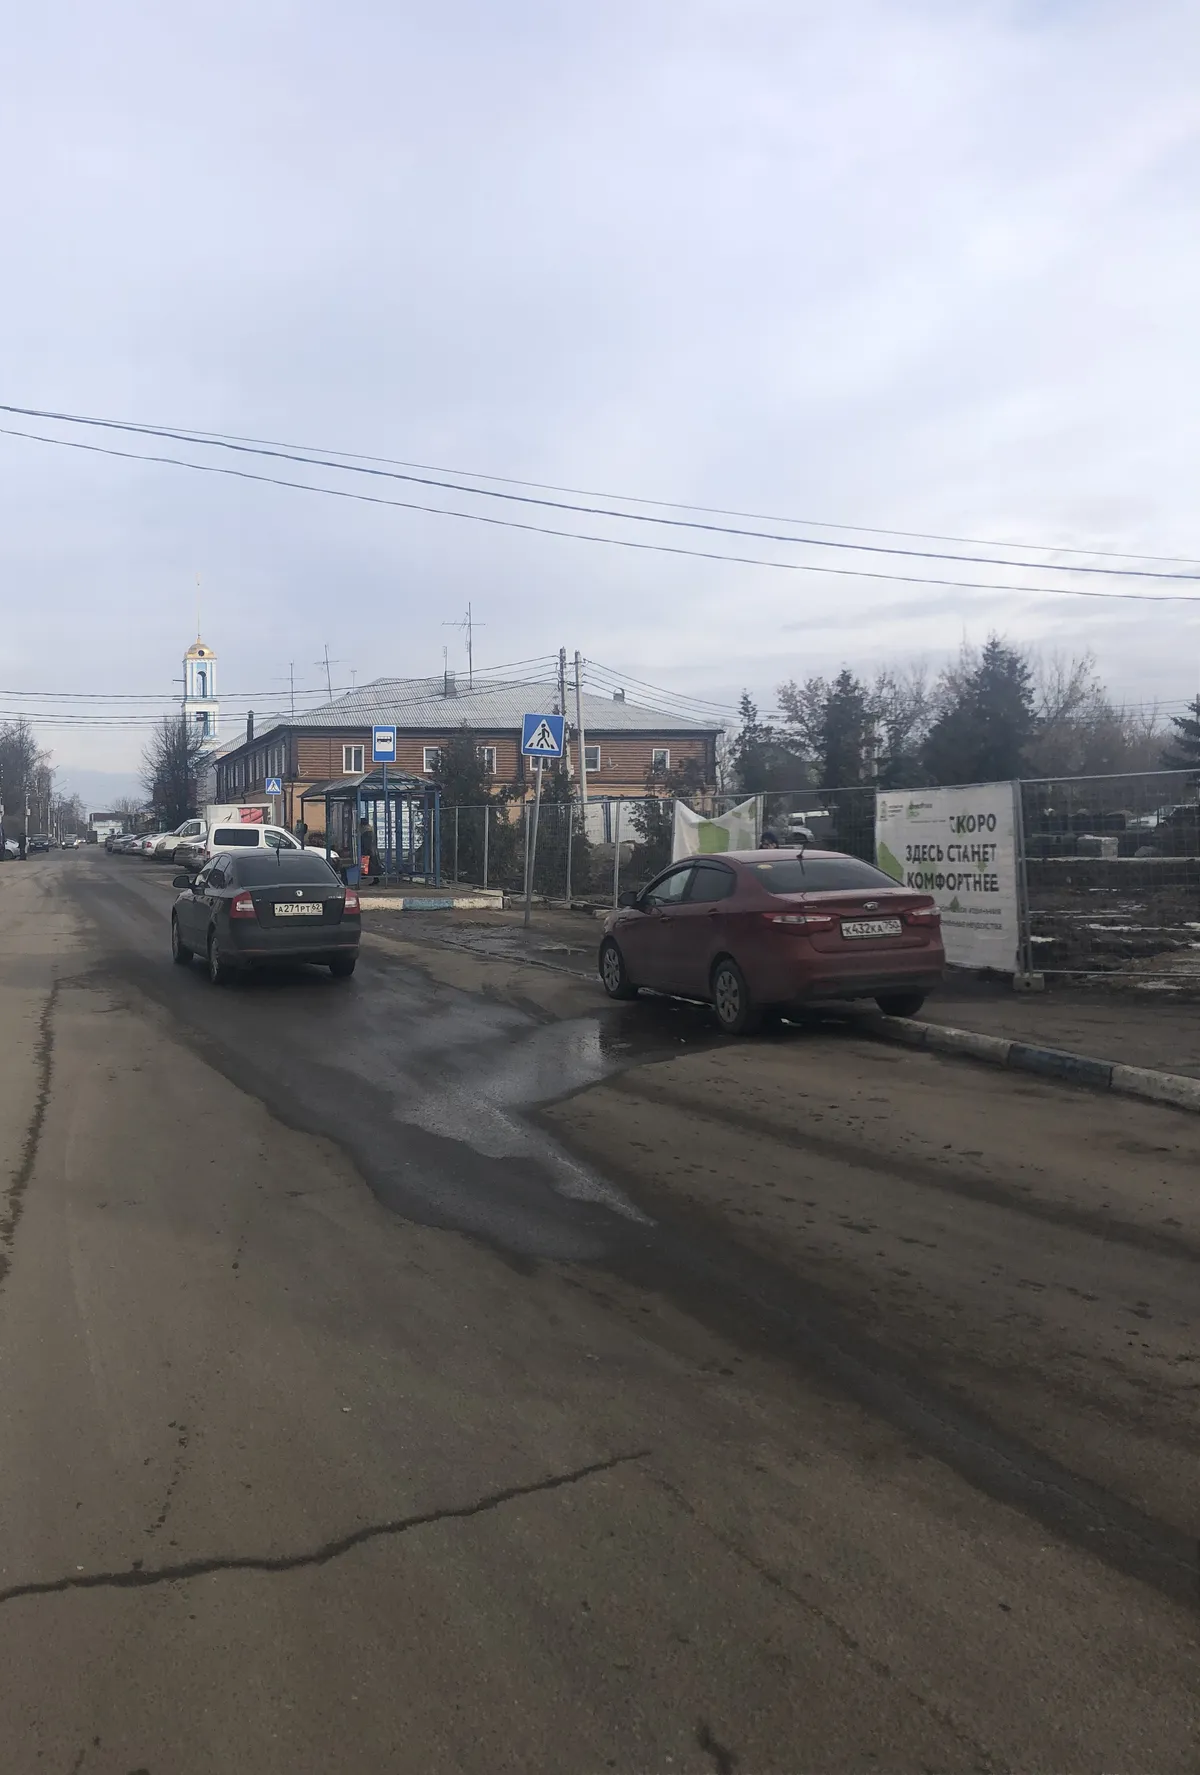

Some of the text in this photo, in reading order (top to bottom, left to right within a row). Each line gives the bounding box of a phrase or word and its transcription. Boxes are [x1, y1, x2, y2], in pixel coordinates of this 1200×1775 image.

[905, 843, 997, 864] ЗДЕСЬ СТАНЕТ
[906, 871, 999, 892] КОМФОРТНЕЕ
